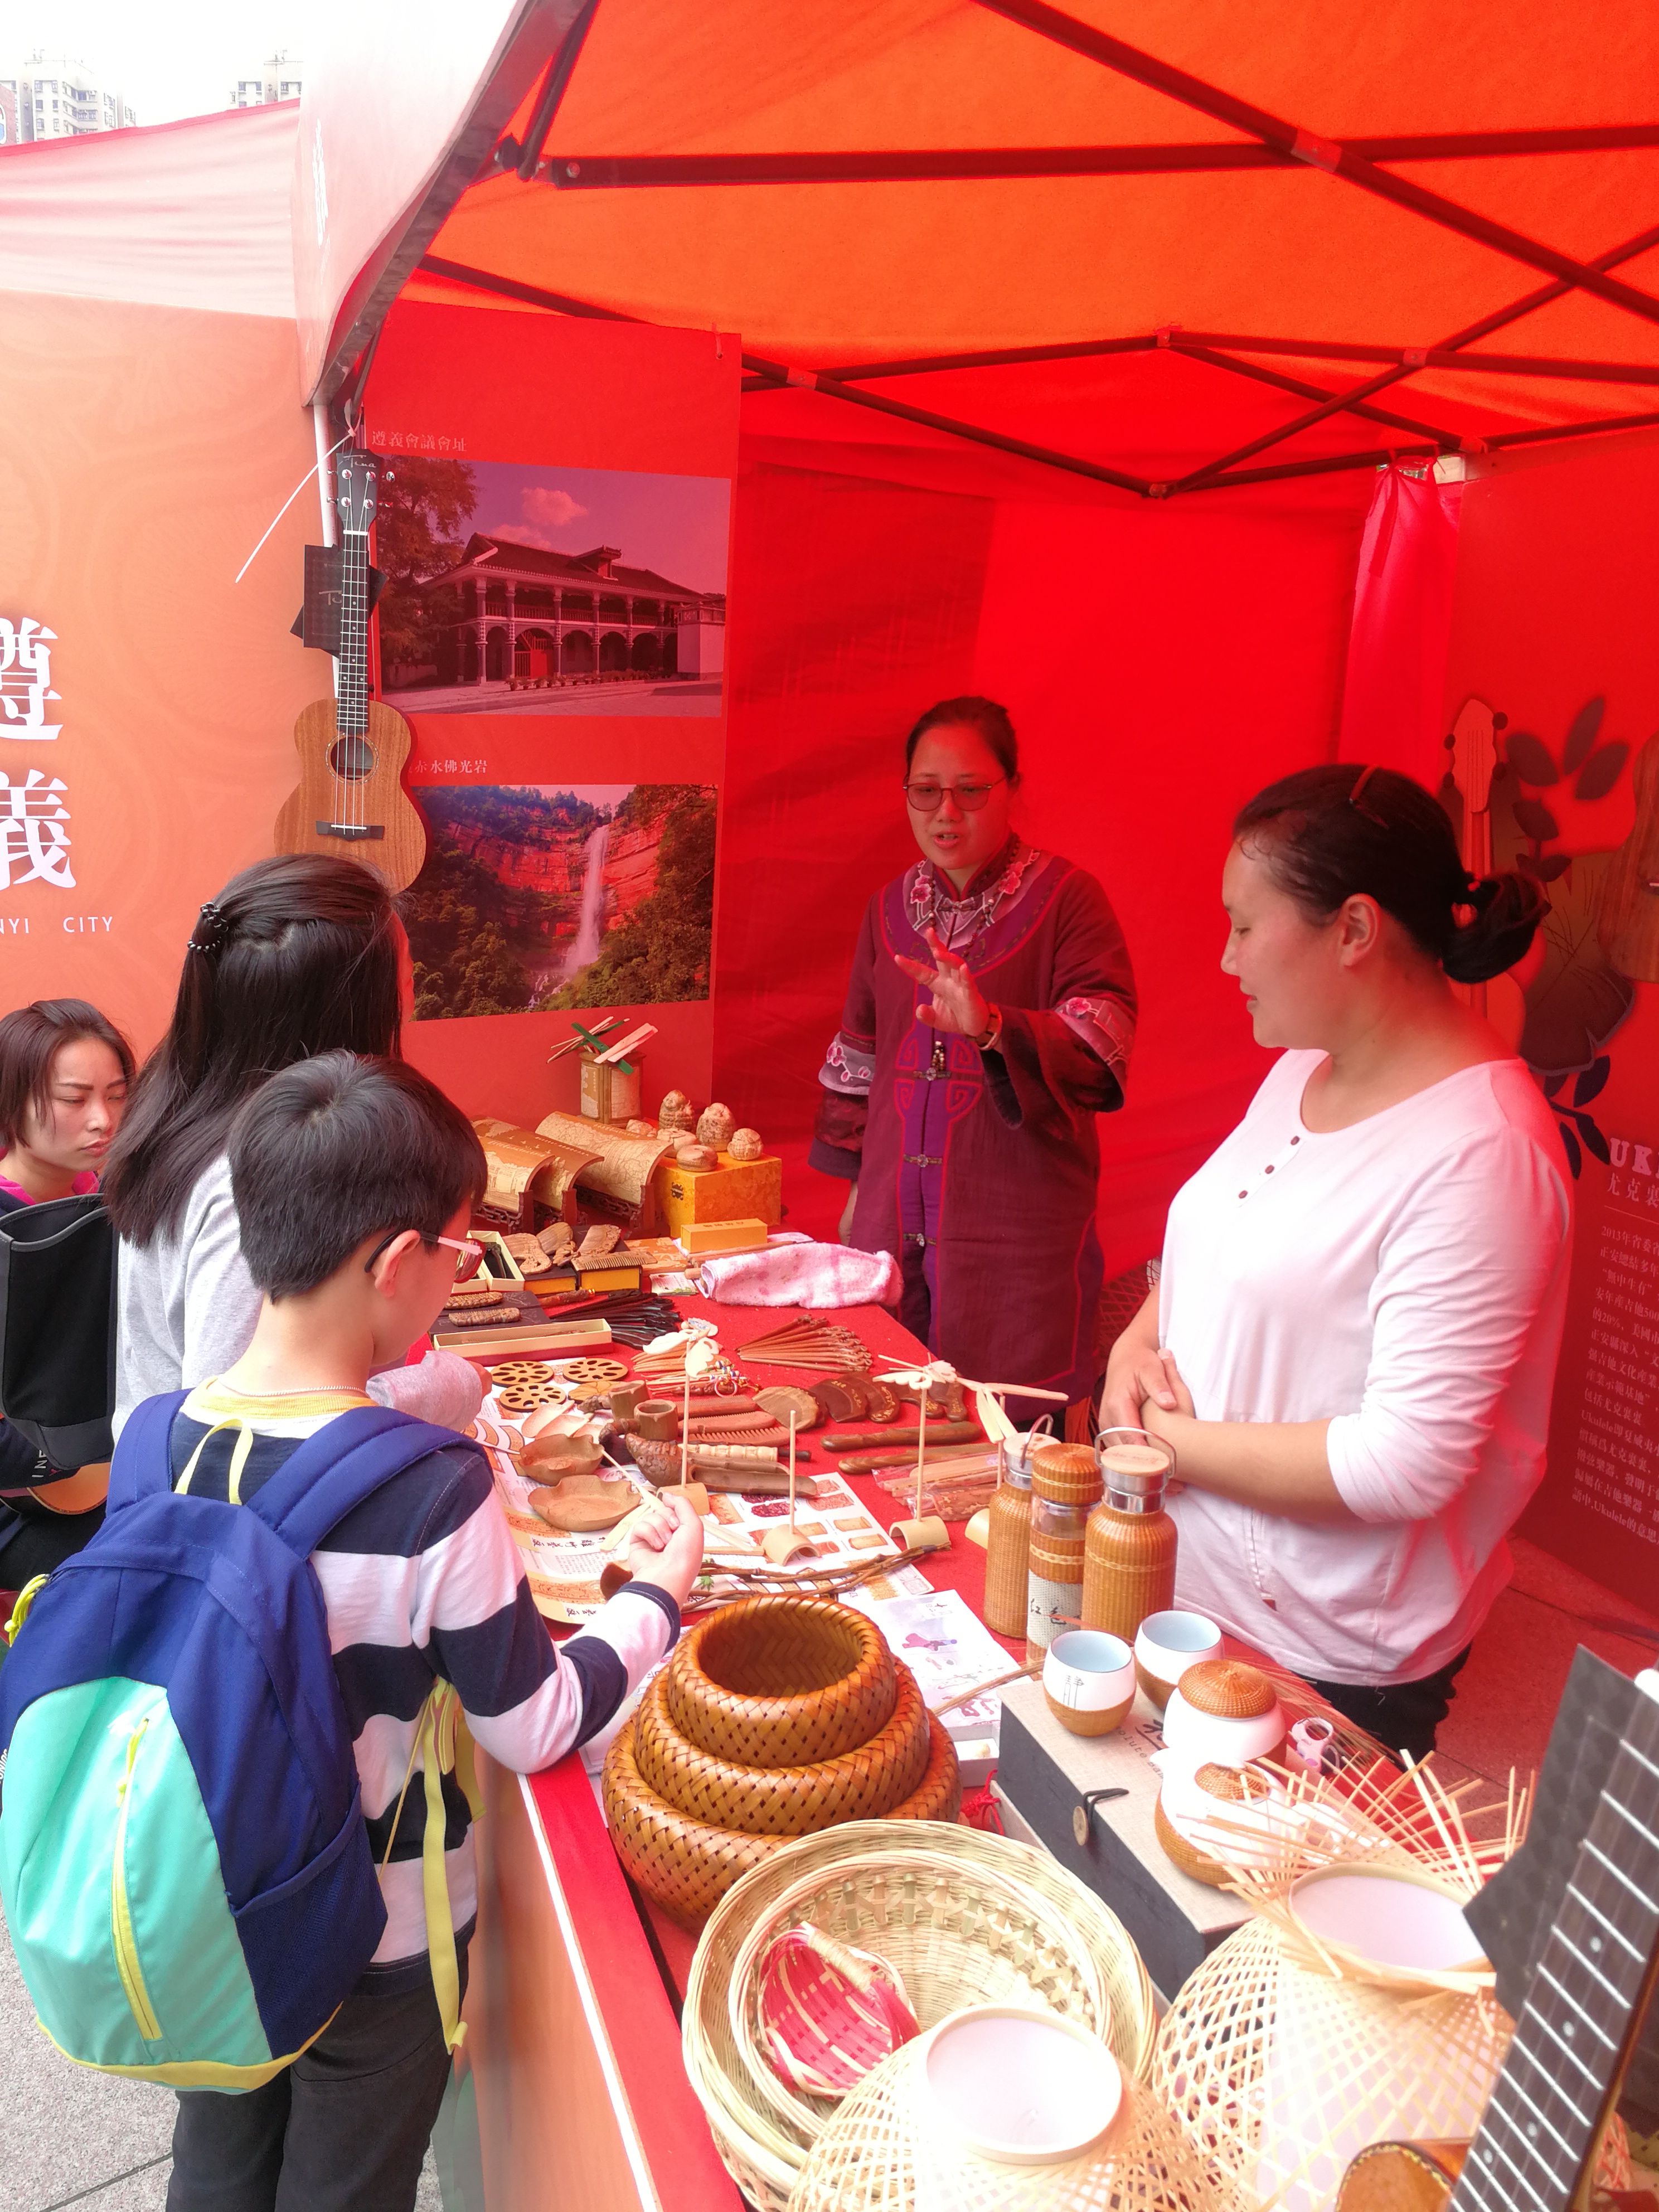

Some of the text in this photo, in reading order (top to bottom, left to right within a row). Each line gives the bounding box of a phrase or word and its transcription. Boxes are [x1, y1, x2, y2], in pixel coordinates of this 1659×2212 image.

[371, 430, 467, 452] 遵義會議會址
[409, 759, 488, 774] 赤水佛光岩
[63, 916, 113, 933] CITY
[1610, 1137, 1659, 1180] UK
